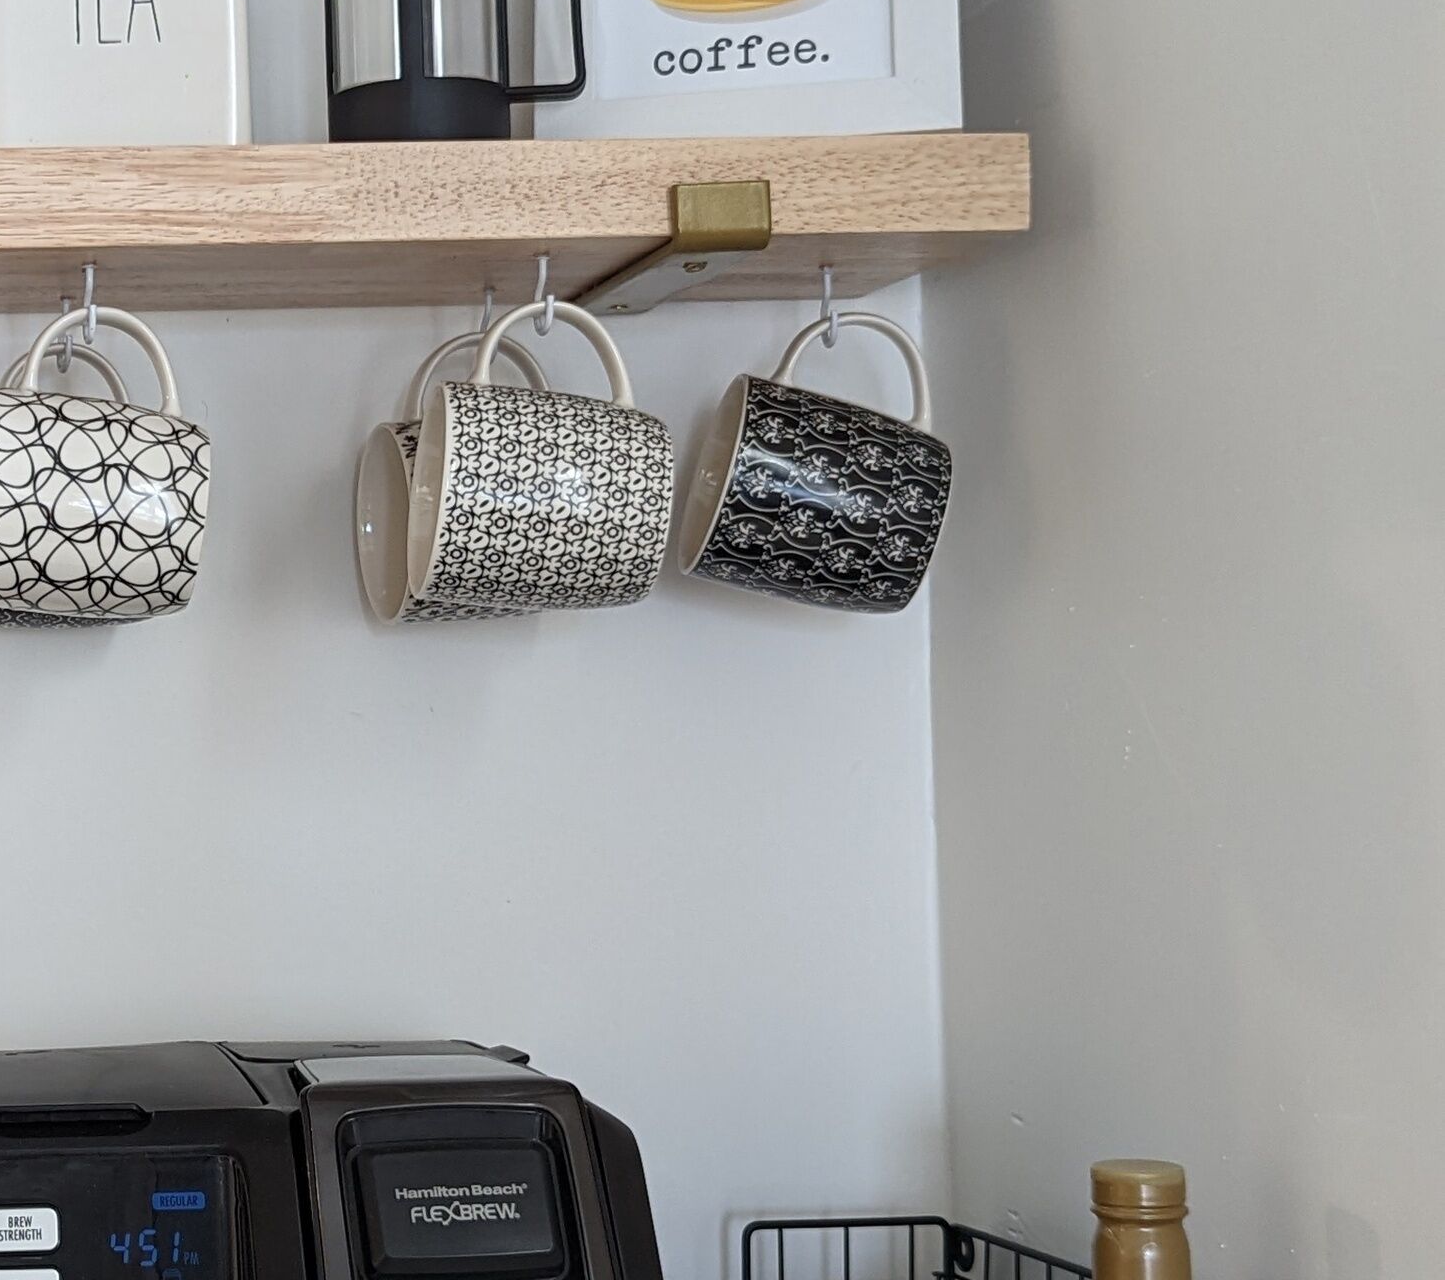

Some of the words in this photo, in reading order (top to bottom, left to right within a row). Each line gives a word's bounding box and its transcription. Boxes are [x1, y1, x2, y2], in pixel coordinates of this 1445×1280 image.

[653, 35, 829, 76] coffee.
[395, 1185, 470, 1200] Hamilton
[159, 1195, 198, 1207] REGULAR
[8, 1215, 33, 1228] BREW
